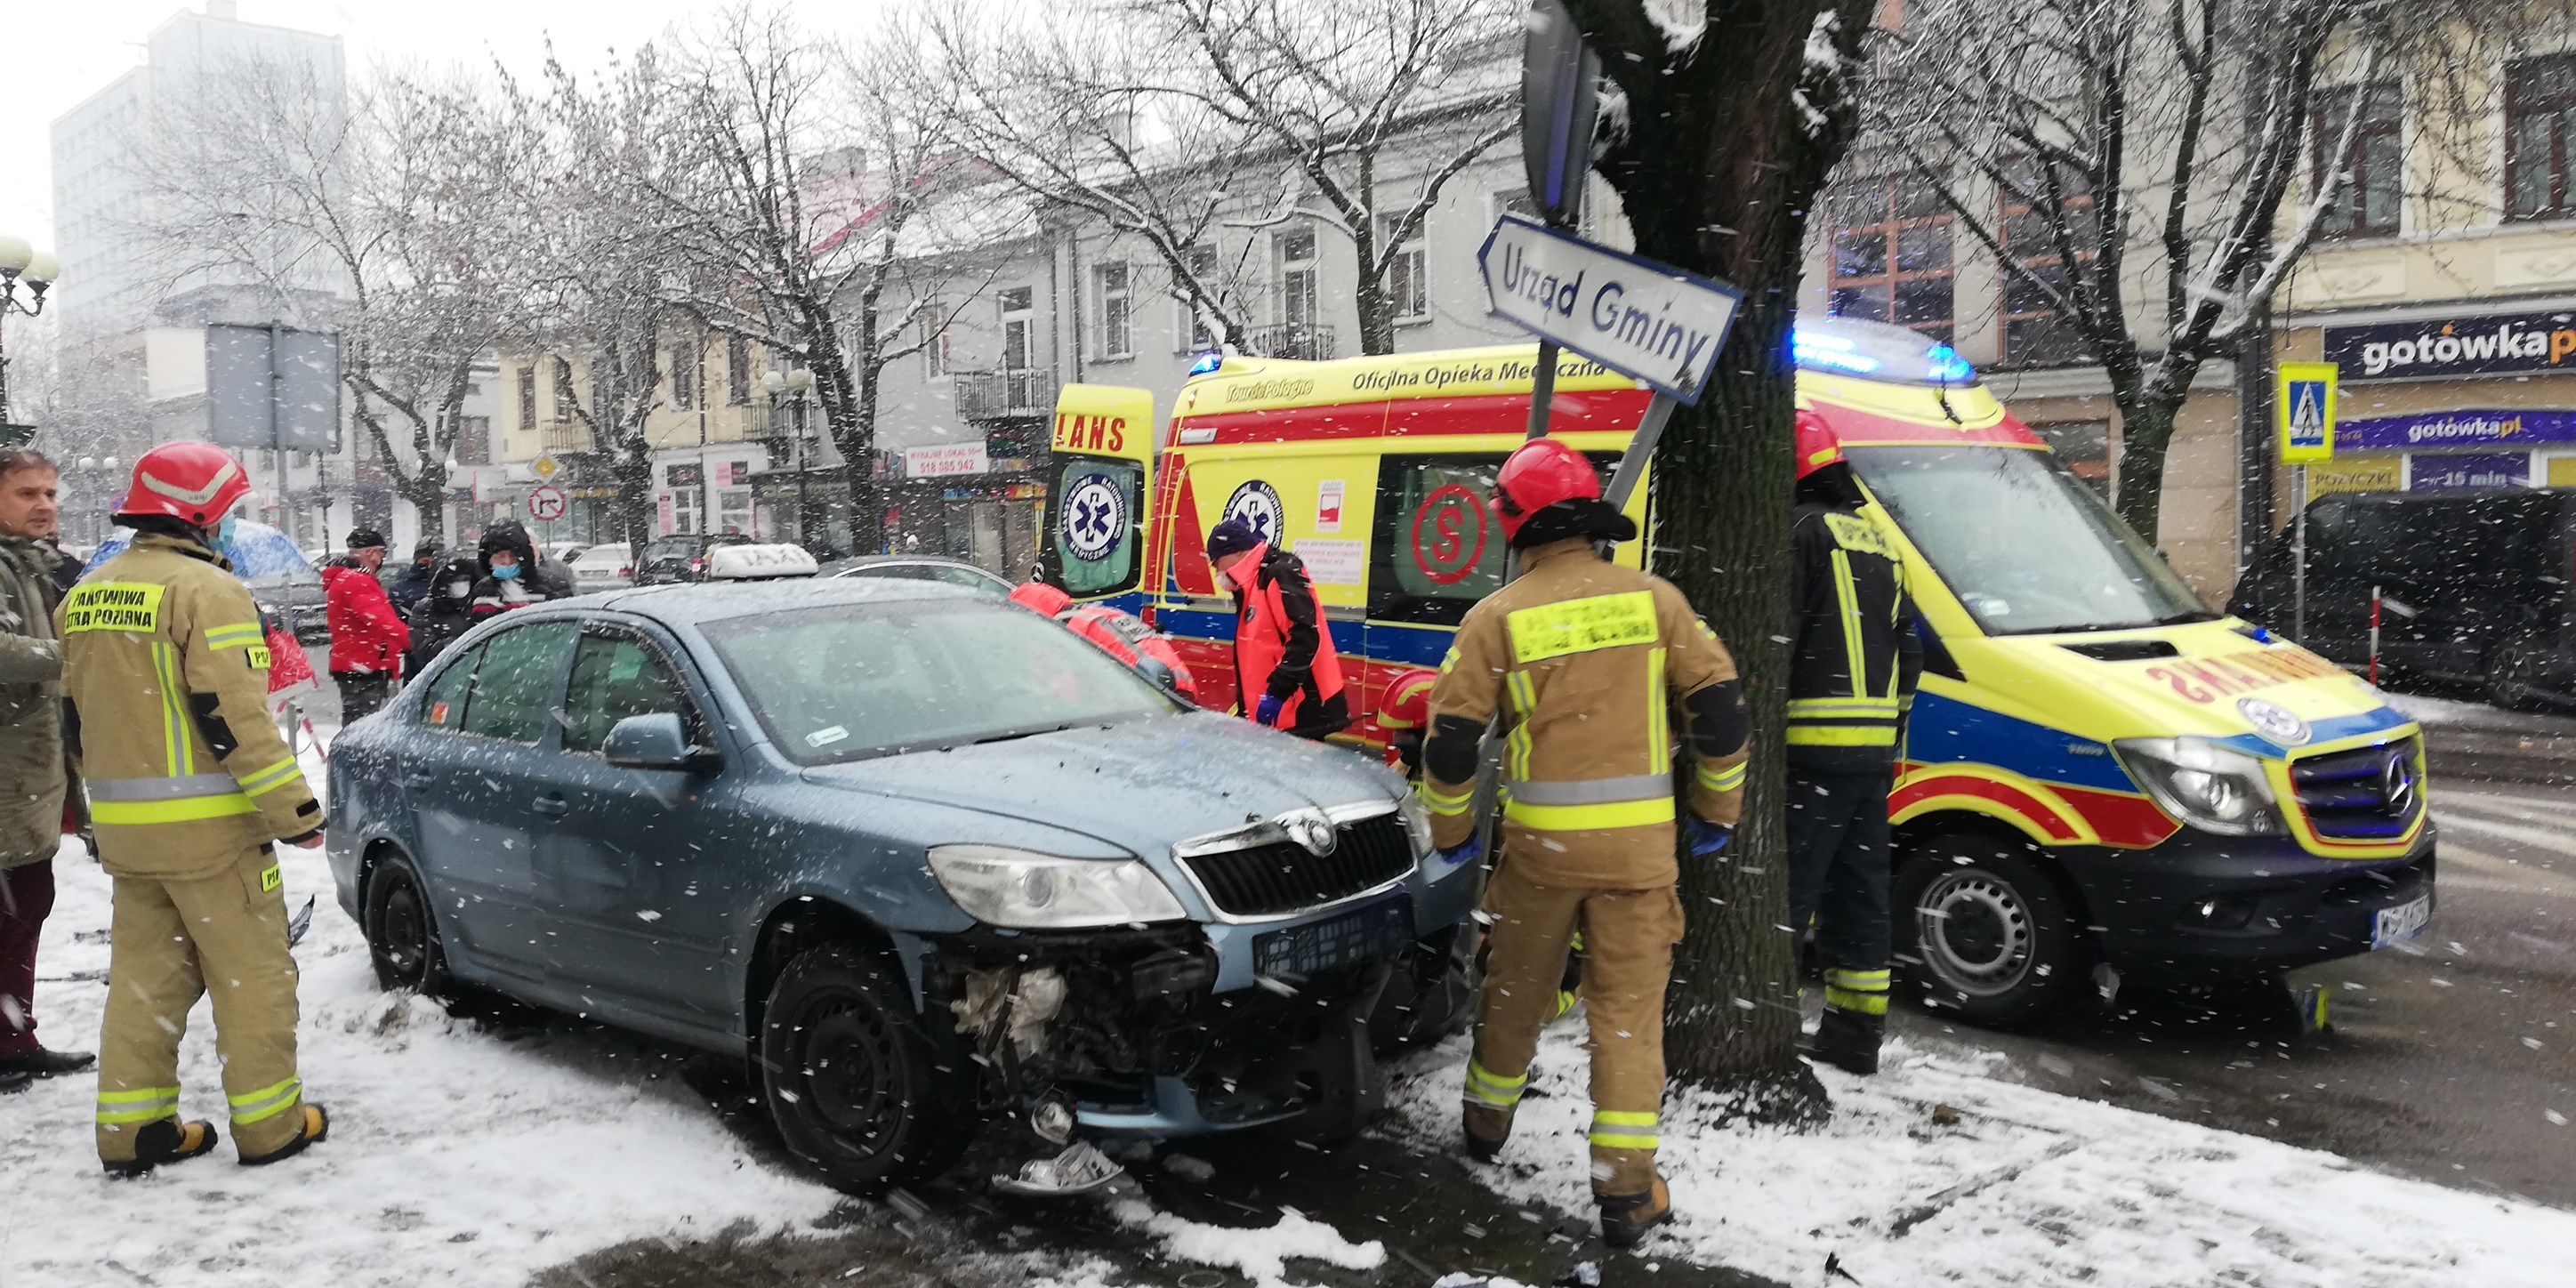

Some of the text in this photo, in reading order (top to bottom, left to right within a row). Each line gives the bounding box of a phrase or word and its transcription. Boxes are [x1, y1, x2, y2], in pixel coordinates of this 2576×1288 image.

[1503, 242, 1710, 382] Urząd Gminy
[1425, 364, 1493, 390] Opieka
[1498, 359, 1607, 381] Meczna
[2408, 415, 2522, 443] gotówkapl
[2468, 469, 2508, 487] min
[66, 610, 91, 630] STRA
